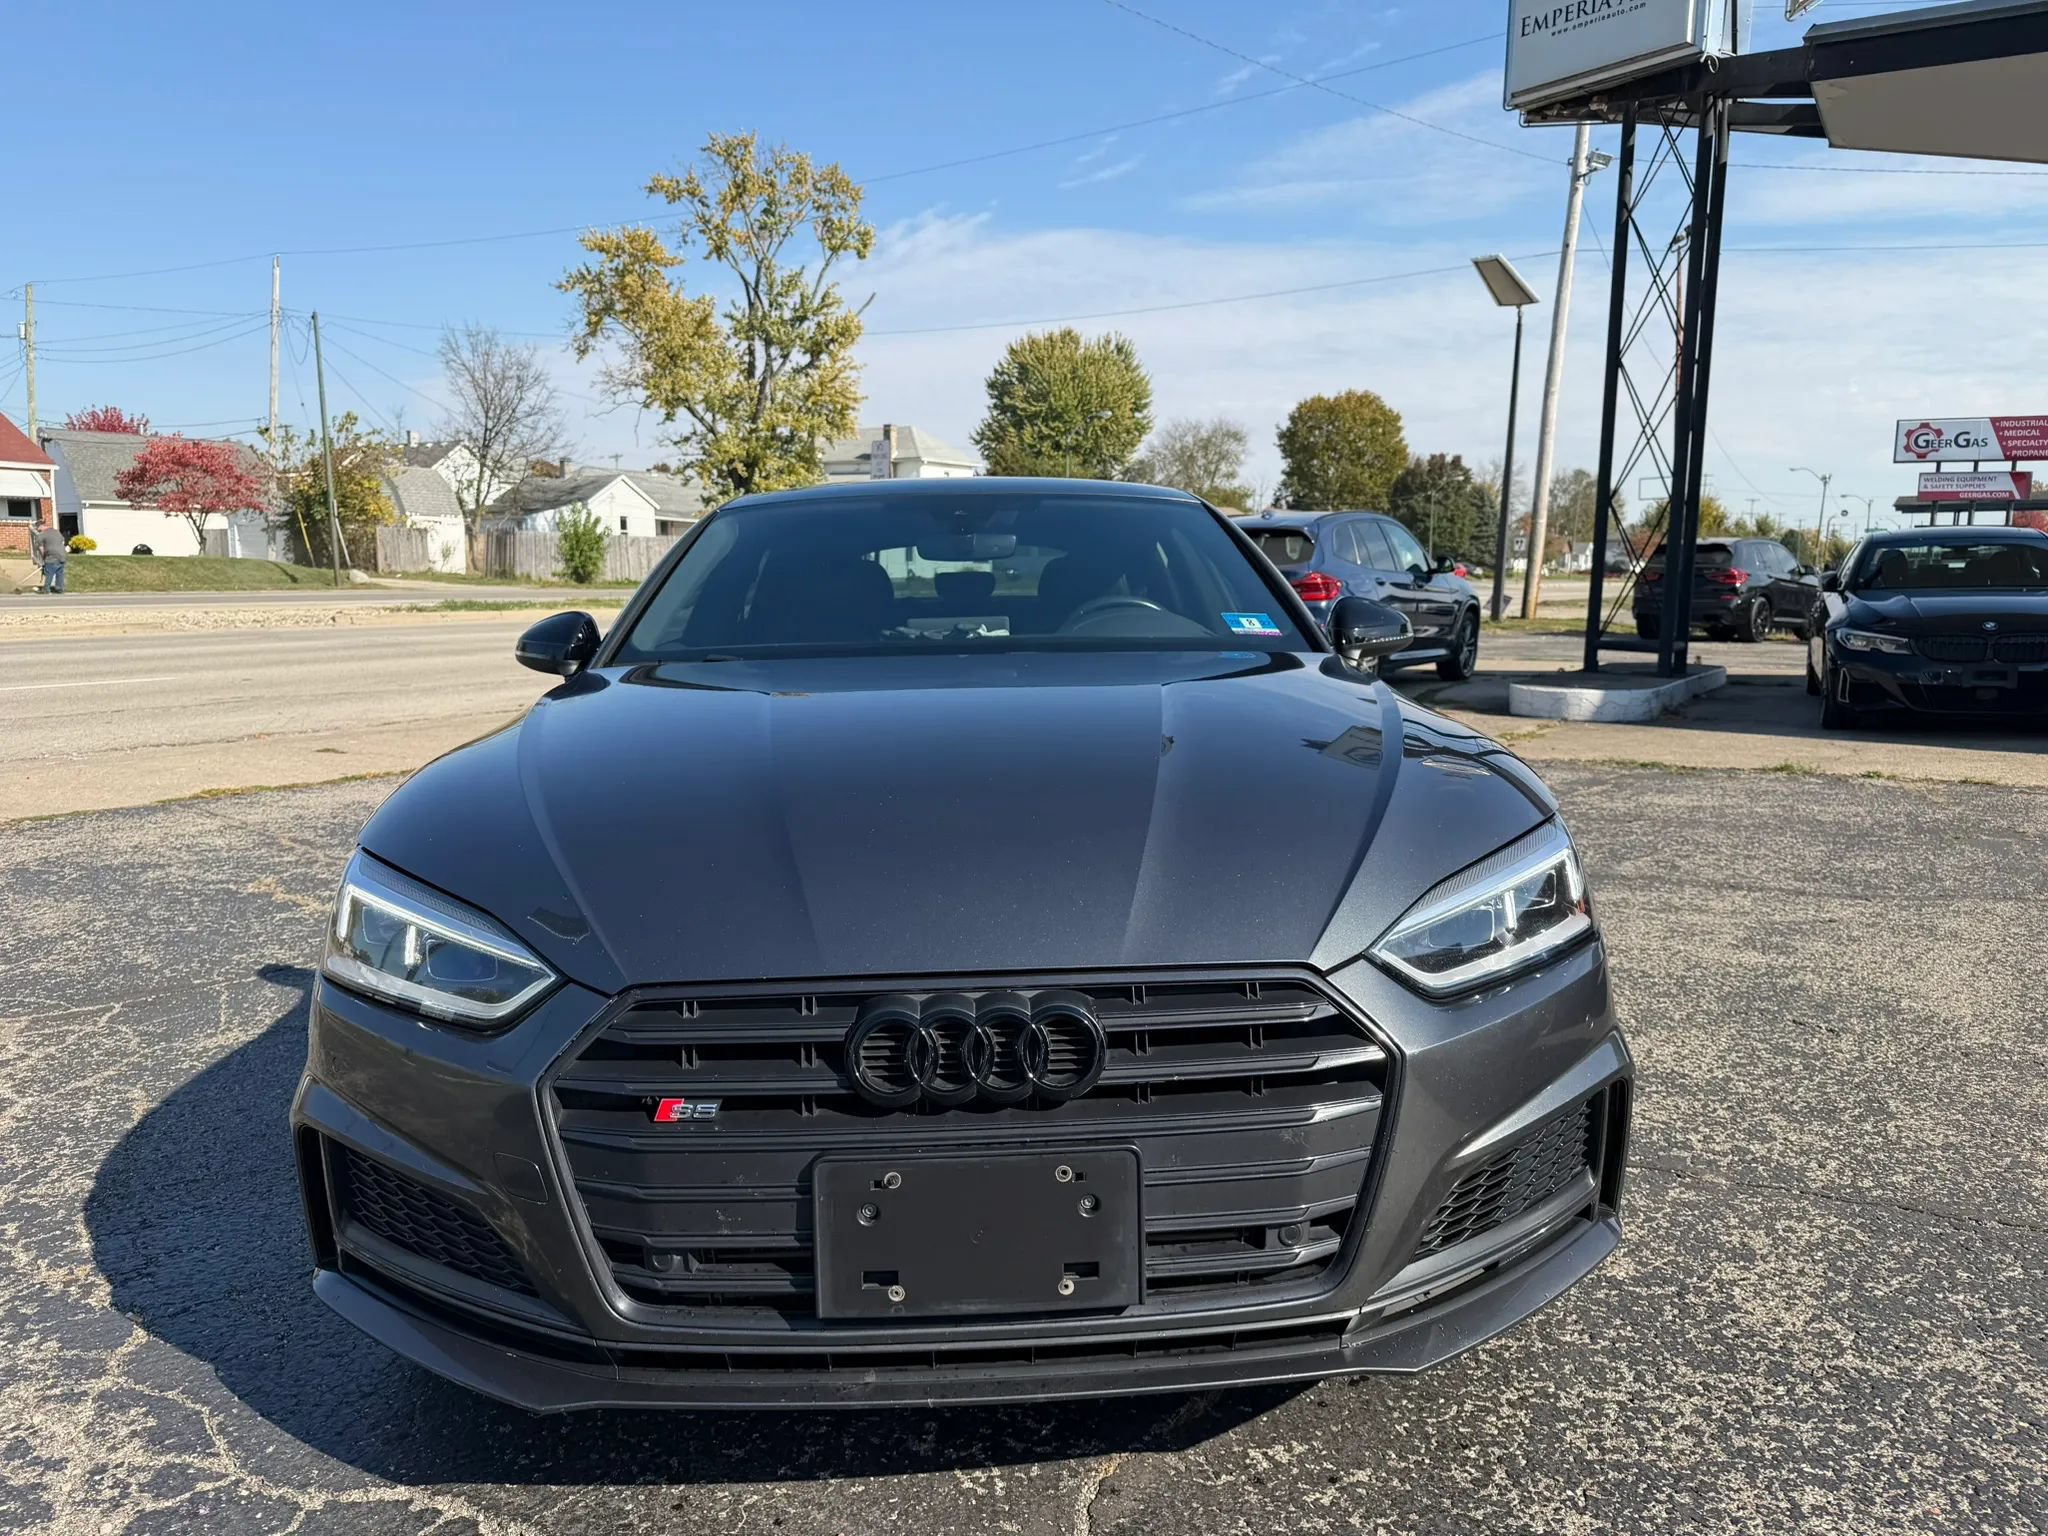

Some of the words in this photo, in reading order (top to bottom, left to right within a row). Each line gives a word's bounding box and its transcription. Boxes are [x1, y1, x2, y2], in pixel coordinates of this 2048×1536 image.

[1521, 0, 1612, 37] EMPERIA
[2000, 419, 2048, 427] INDUSTRIAL
[2007, 439, 2048, 447] SPECIALTY
[669, 1103, 718, 1119] S5
